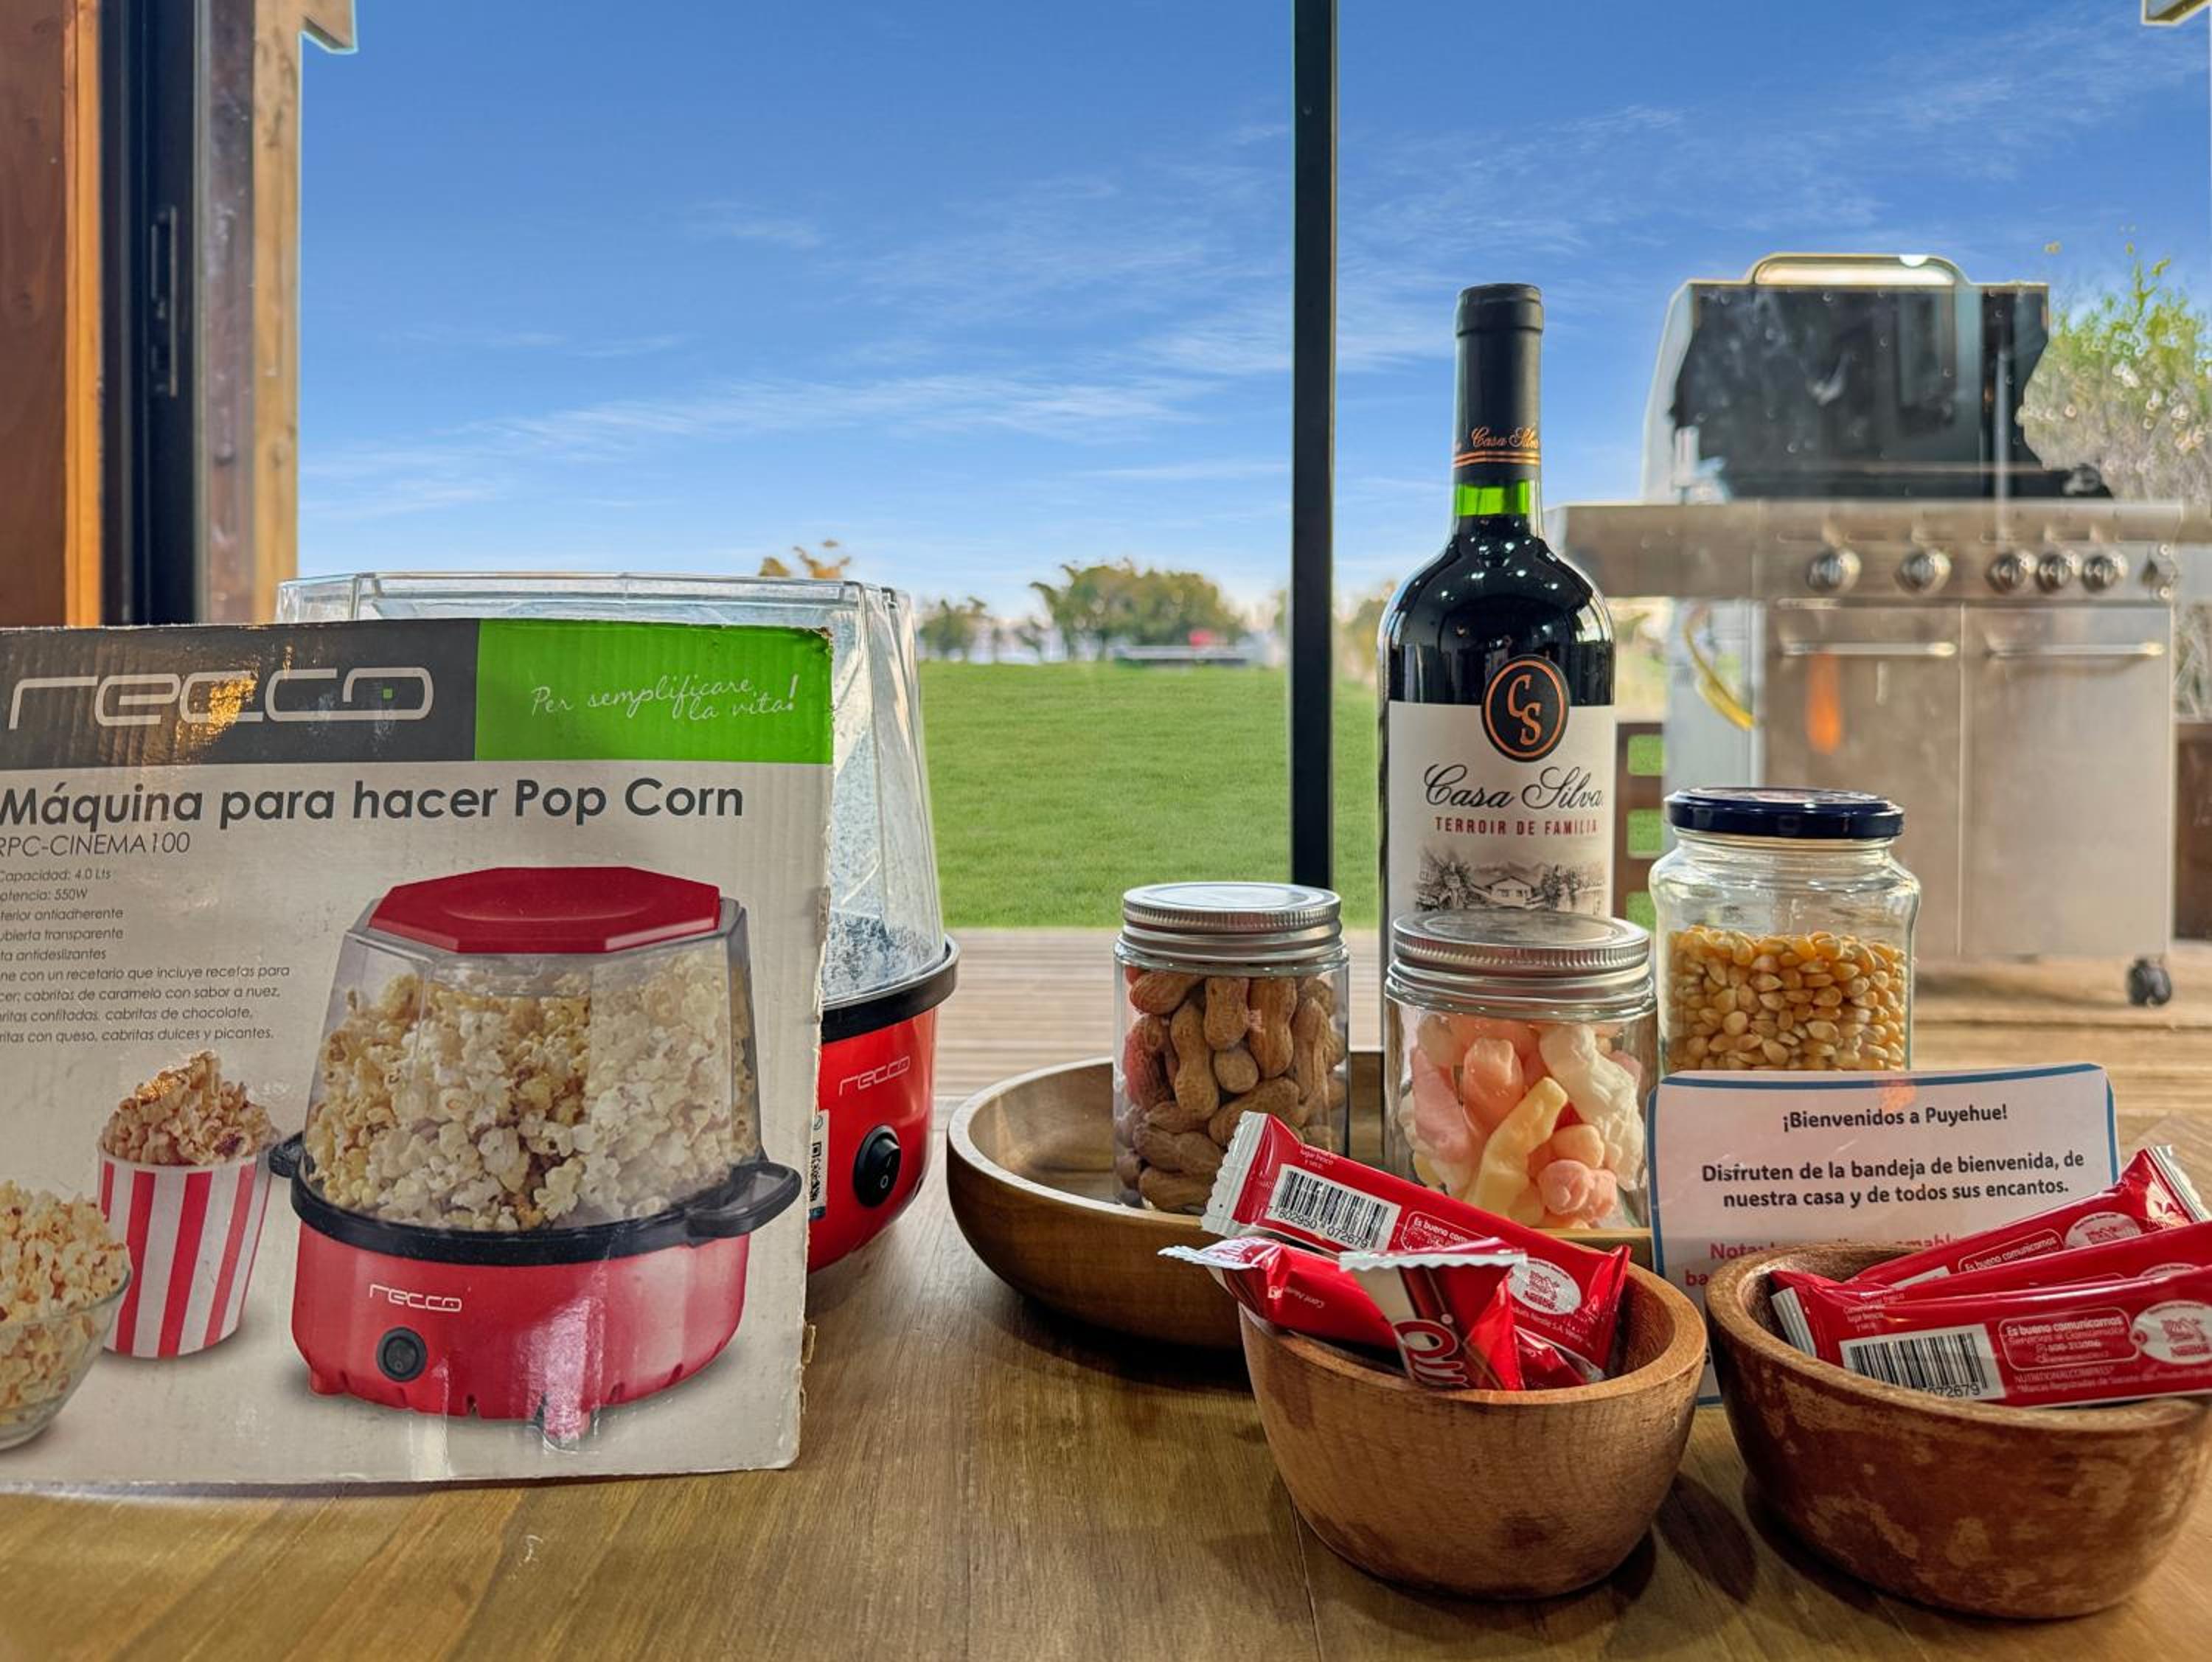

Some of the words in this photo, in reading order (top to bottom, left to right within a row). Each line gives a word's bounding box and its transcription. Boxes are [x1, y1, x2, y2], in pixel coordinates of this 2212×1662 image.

[530, 686, 574, 720] Per
[587, 672, 754, 720] semplificare
[689, 701, 720, 720] la
[732, 674, 799, 717] vita!
[1424, 763, 1514, 809] Casa
[1521, 766, 1605, 810] Silva
[0, 782, 202, 832] Máquina
[220, 790, 335, 830] para
[353, 779, 499, 819] hacer
[515, 779, 608, 826] Pop
[625, 777, 743, 817] Corn
[1435, 816, 1506, 835] TERROIR
[1516, 819, 1536, 835] DE
[1544, 819, 1599, 835] FAMILIA
[54, 886, 88, 901] 550W
[35, 908, 124, 922] antiadherente
[44, 927, 124, 943] transparente
[15, 948, 107, 962] antideslizantes
[20, 970, 45, 982] con
[48, 969, 64, 981] un
[66, 967, 125, 981] recetario
[128, 967, 153, 983] que
[157, 967, 203, 981] incluye
[206, 965, 255, 978] recetas
[257, 965, 291, 979] para
[24, 989, 74, 1003] cabritas
[77, 987, 95, 1001] de
[99, 987, 162, 1001] caramelo
[165, 988, 191, 1000] con
[194, 986, 231, 999] sabor
[234, 987, 243, 998] a
[105, 1006, 157, 1021] cabritas
[161, 1006, 179, 1020] de
[27, 1032, 53, 1044] con
[102, 1028, 154, 1042] cabritas
[157, 1028, 201, 1041] dulces
[204, 1030, 212, 1040] y
[1783, 1108, 1905, 1133] ¡Bienvenidos
[1908, 1113, 1920, 1124] a
[1924, 1104, 2008, 1127] Puyehue!
[1702, 1163, 1793, 1182] Disfruten
[1799, 1162, 1823, 1180] de
[1829, 1161, 1845, 1179] la
[1851, 1158, 1926, 1181] bandeja
[1930, 1157, 1953, 1175] de
[1958, 1151, 2059, 1174] bienvenida,
[2063, 1150, 2084, 1167] de
[1723, 1191, 1798, 1208] nuestra
[1803, 1191, 1845, 1206] casa
[1849, 1191, 1863, 1209] y
[1867, 1186, 1891, 1203] de
[1895, 1183, 1948, 1202] todos
[1952, 1184, 1981, 1200] sus
[1986, 1179, 2069, 1197] encantos.
[1326, 1225, 1369, 1250] 072679
